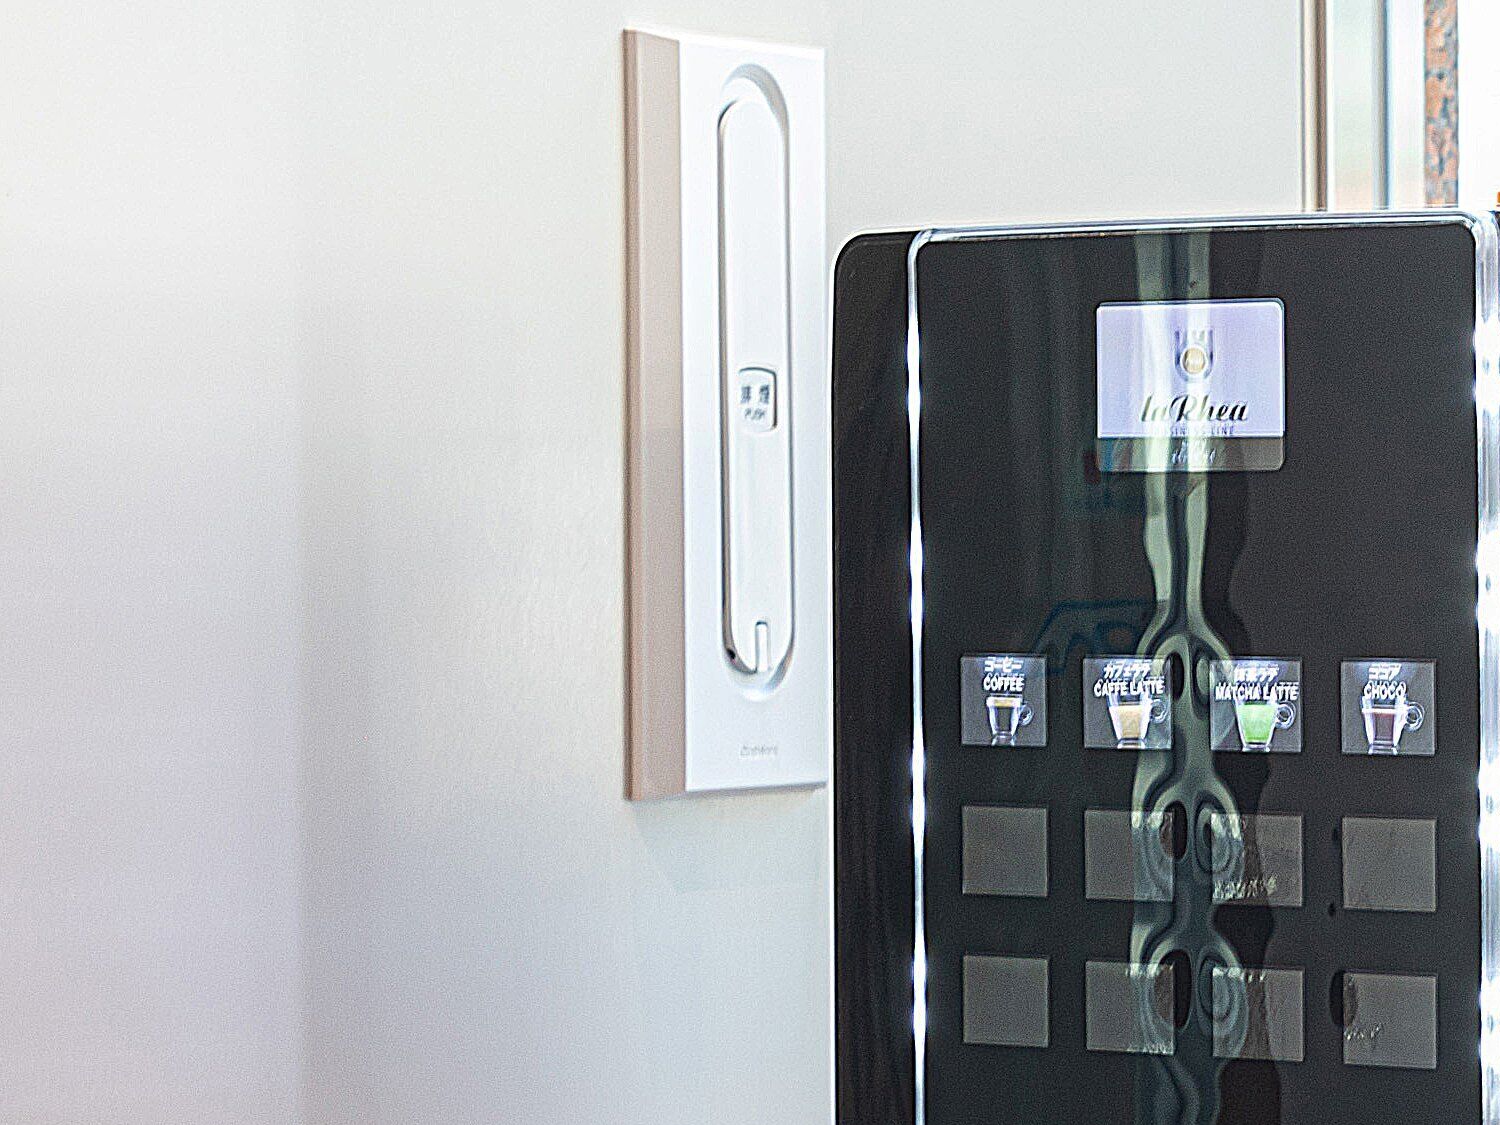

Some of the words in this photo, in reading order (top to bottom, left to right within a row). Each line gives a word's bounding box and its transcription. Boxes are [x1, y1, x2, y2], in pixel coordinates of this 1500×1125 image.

[1141, 393, 1248, 422] laRhea
[983, 673, 1025, 691] COFFEE
[1094, 678, 1128, 697] CAFFE
[1129, 676, 1166, 695] LATTE
[1215, 682, 1261, 700] MATCHA
[1263, 681, 1300, 700] LATTE
[1363, 681, 1407, 700] CHOCO
